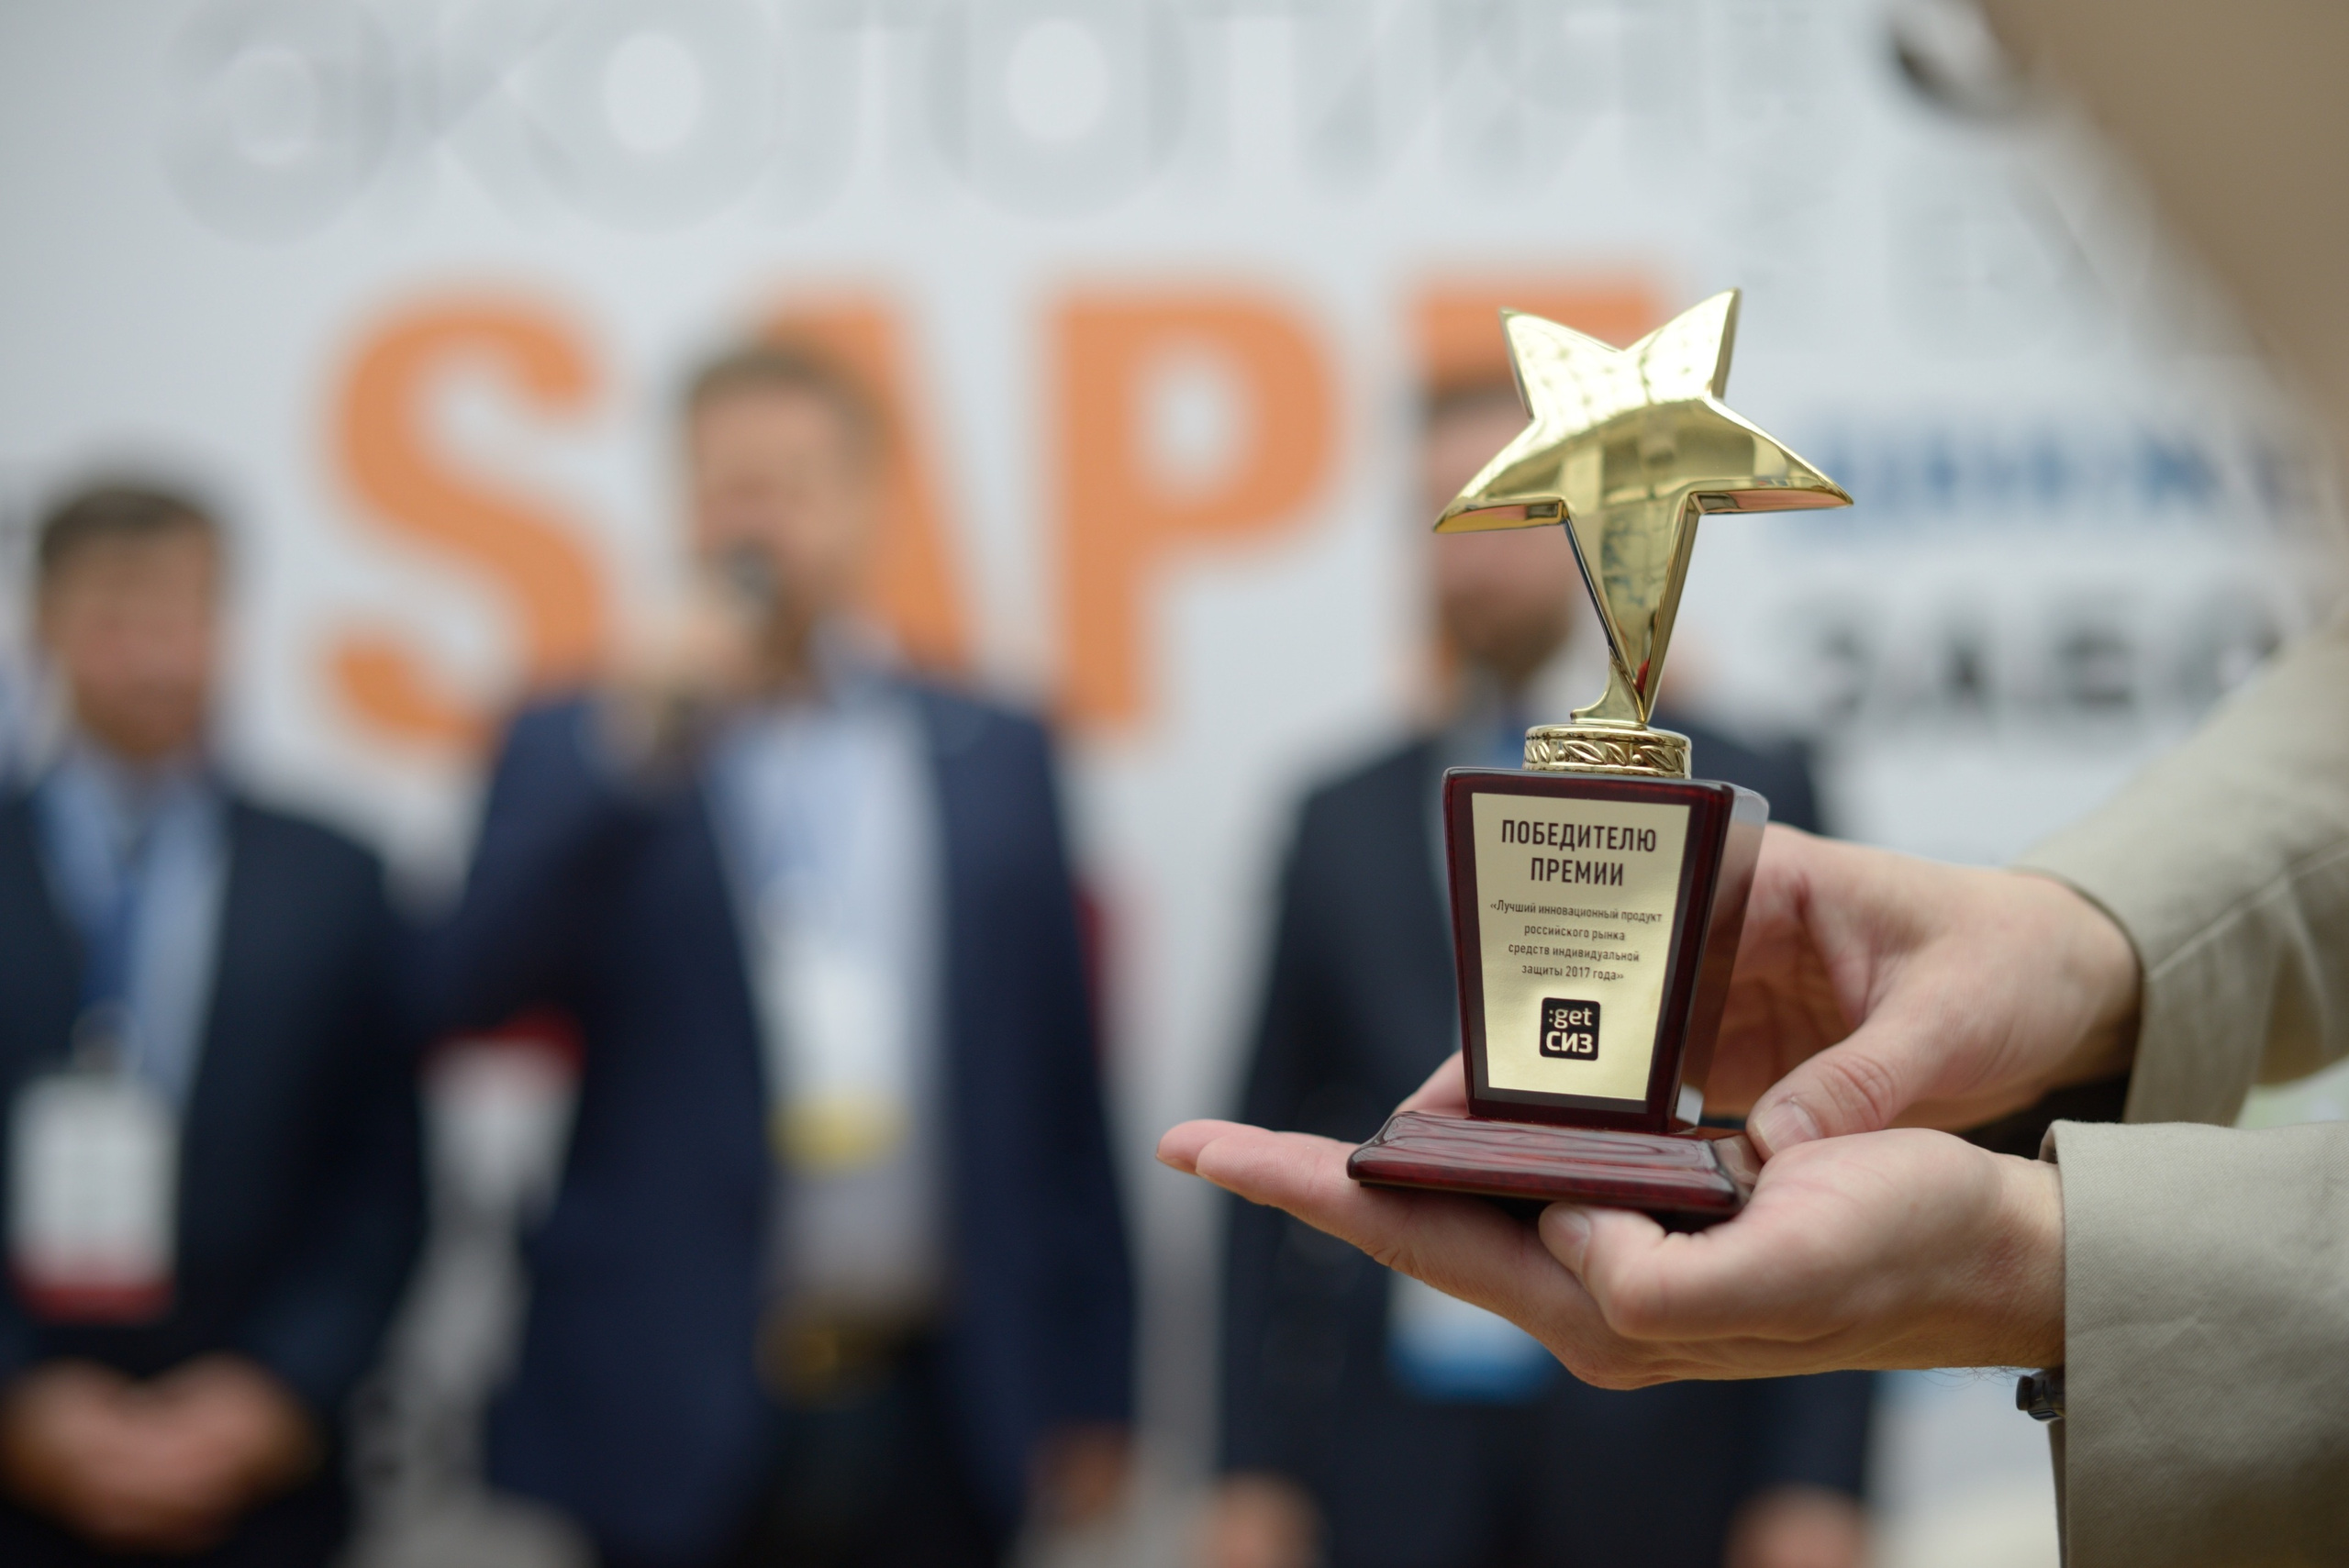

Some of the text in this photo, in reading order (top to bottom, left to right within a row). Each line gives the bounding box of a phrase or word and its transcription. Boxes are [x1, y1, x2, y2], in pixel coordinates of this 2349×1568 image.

[328, 286, 1668, 751] SAP
[1500, 818, 1657, 852] ПОБЕДИТЕЛЮ
[1530, 857, 1624, 887] ПРЕМИИ
[1490, 899, 1663, 925] «Лучший инновационный продукт
[1524, 924, 1625, 941] российского рынка
[1508, 942, 1640, 962] средств индивидуальной
[1521, 964, 1624, 982] защиты 2017 года»
[1548, 1006, 1593, 1030] :get
[1545, 1029, 1595, 1055] СИЗ
